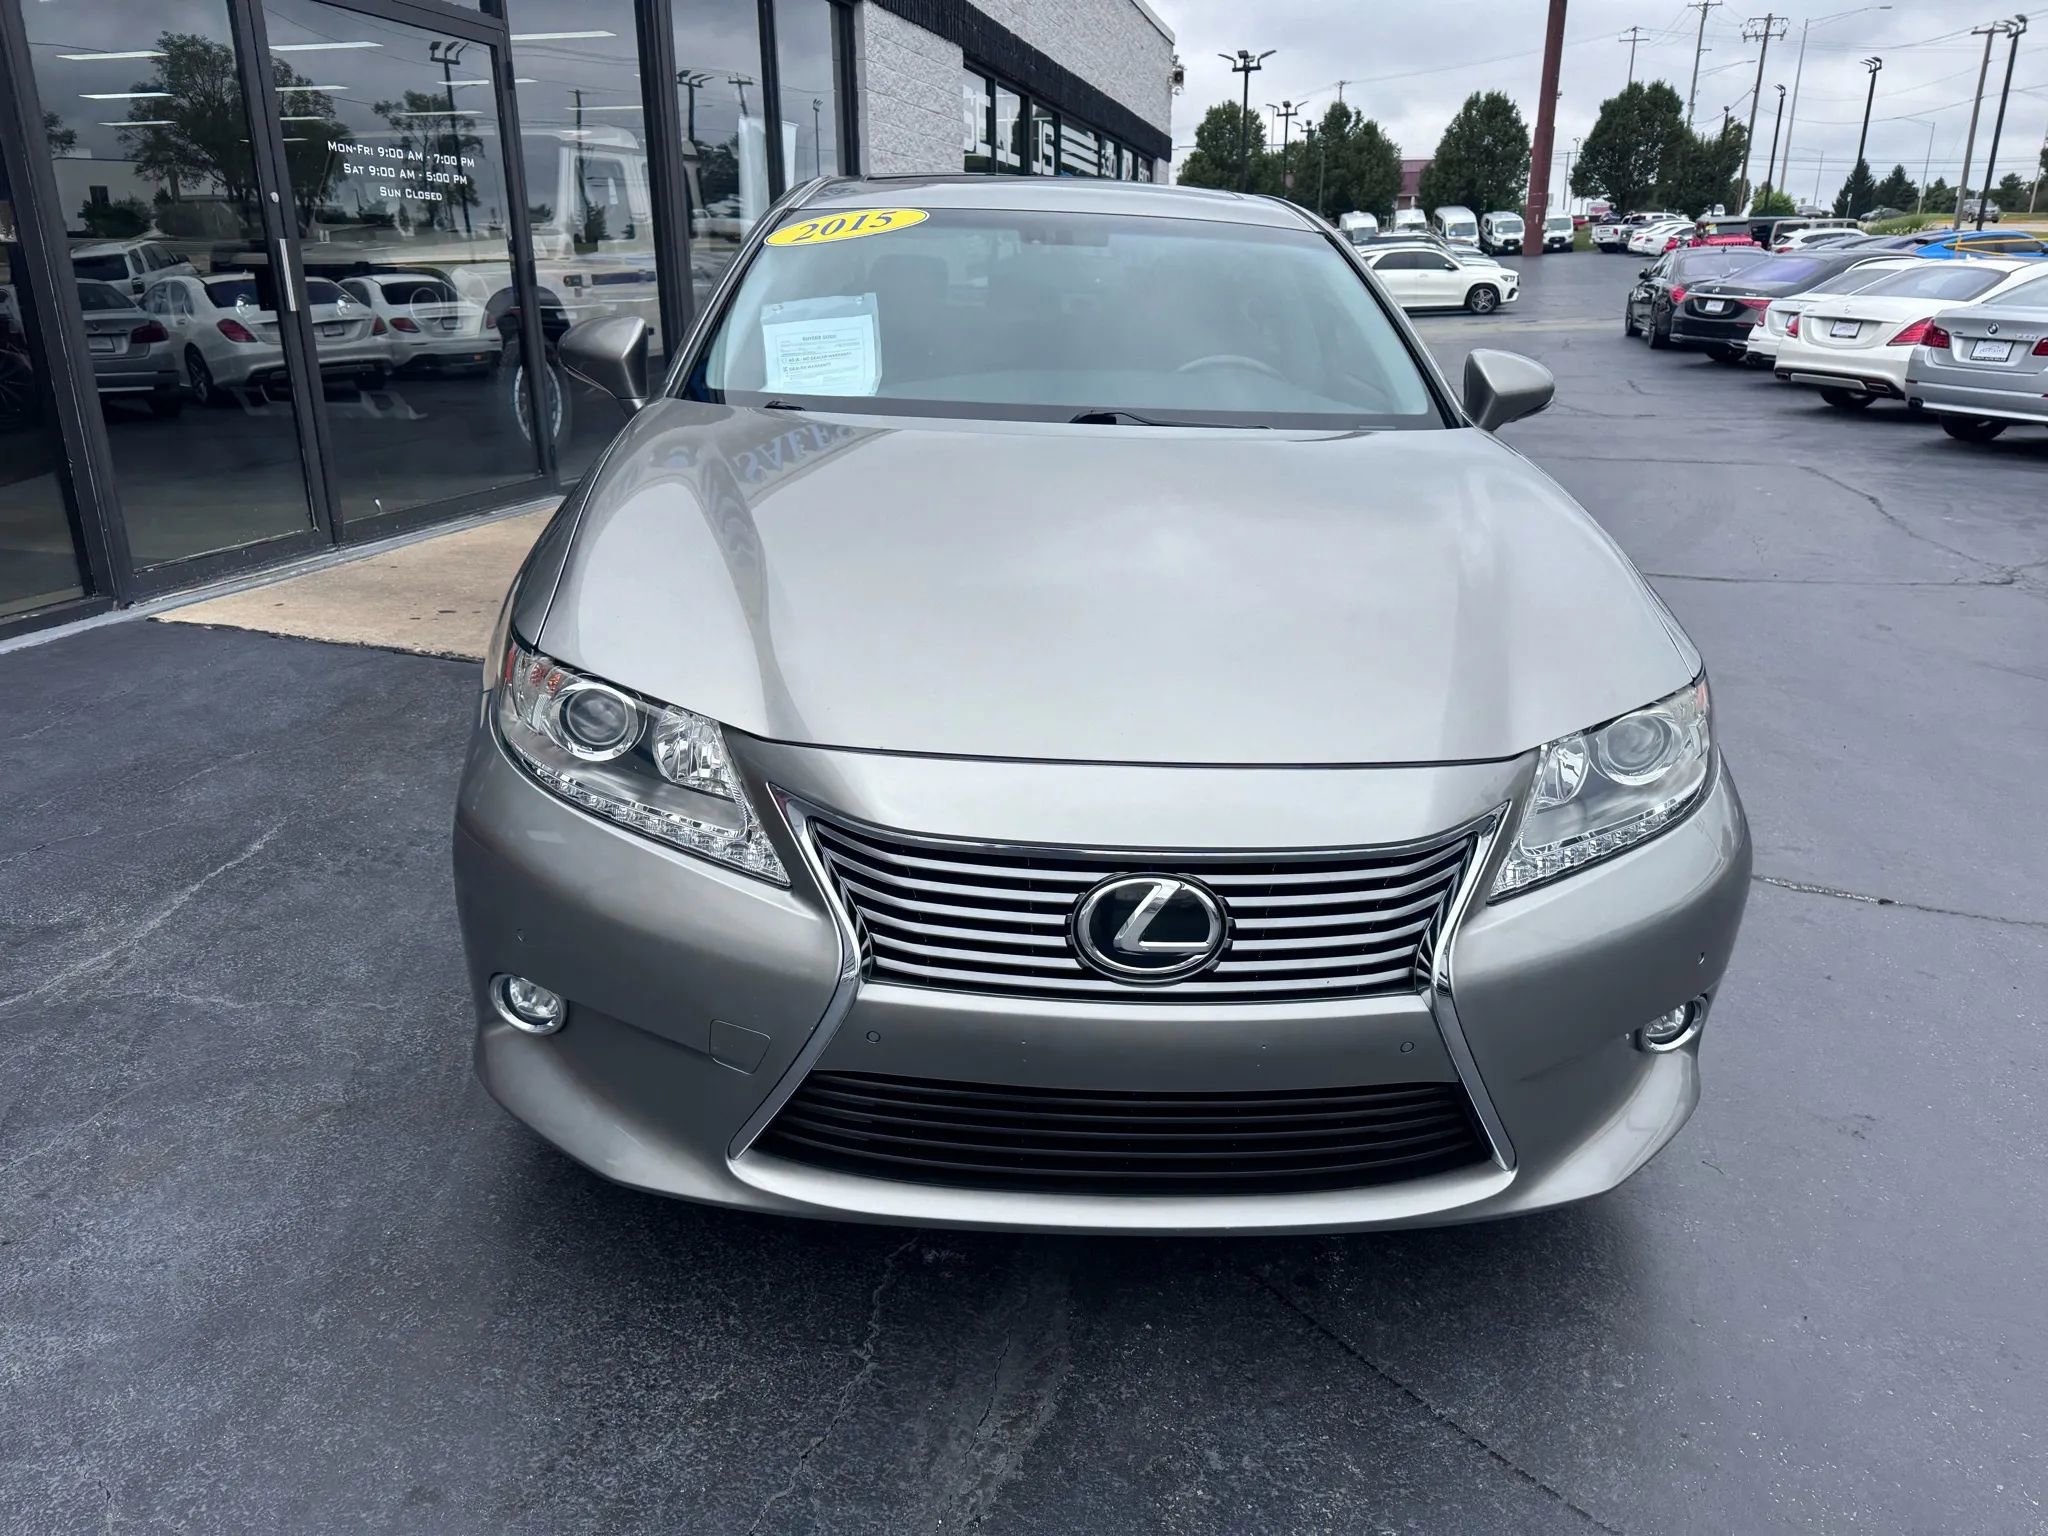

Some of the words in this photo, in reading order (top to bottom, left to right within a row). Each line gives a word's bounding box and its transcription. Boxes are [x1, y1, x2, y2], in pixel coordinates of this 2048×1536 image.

[377, 147, 404, 159] 9:00
[407, 151, 424, 161] AM
[433, 153, 457, 166] 7:00
[460, 157, 475, 168] PM
[343, 163, 364, 175] SAT
[368, 166, 396, 178] 9:00
[399, 169, 415, 180] AM
[426, 171, 450, 184] 5:00
[453, 174, 468, 185] PM
[379, 187, 401, 198] SUN
[405, 188, 443, 201] CLOSED
[791, 211, 897, 242] 2015
